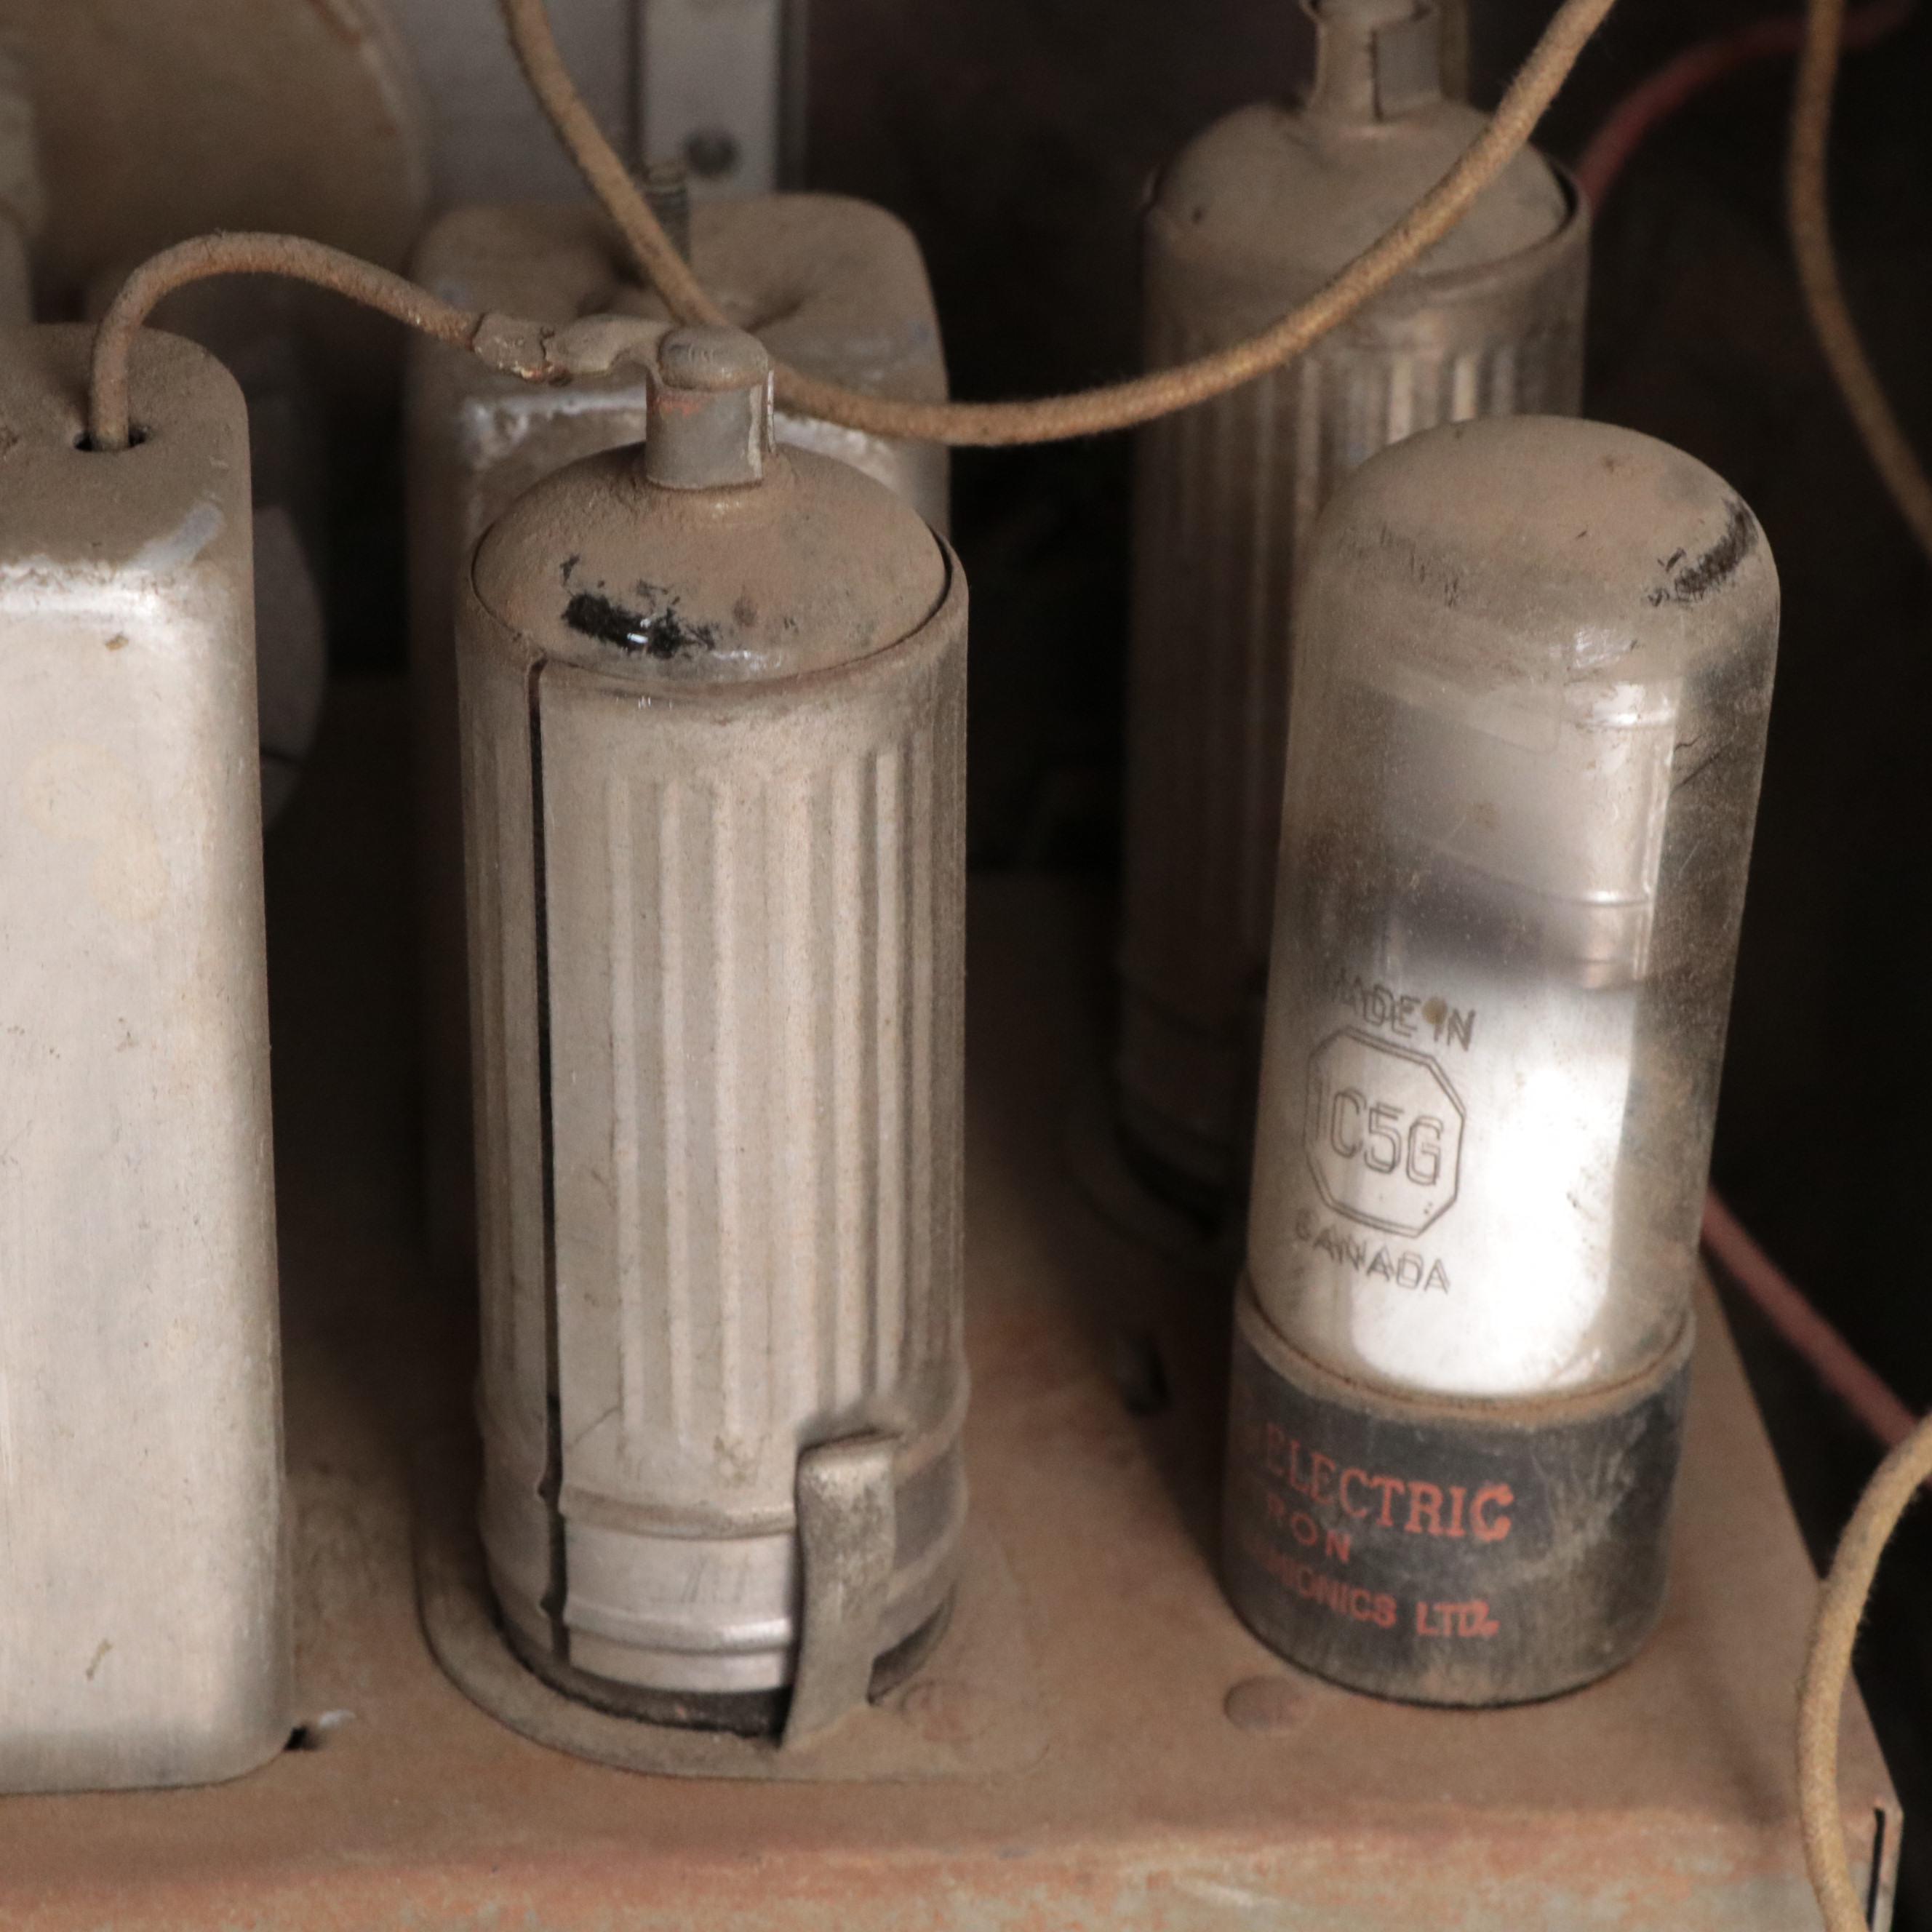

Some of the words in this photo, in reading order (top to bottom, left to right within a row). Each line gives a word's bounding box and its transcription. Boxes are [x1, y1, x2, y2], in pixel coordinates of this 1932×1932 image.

[1432, 999, 1477, 1053] IN
[1294, 1208, 1451, 1296] CANADA
[1266, 1421, 1515, 1542] ELECTRIC
